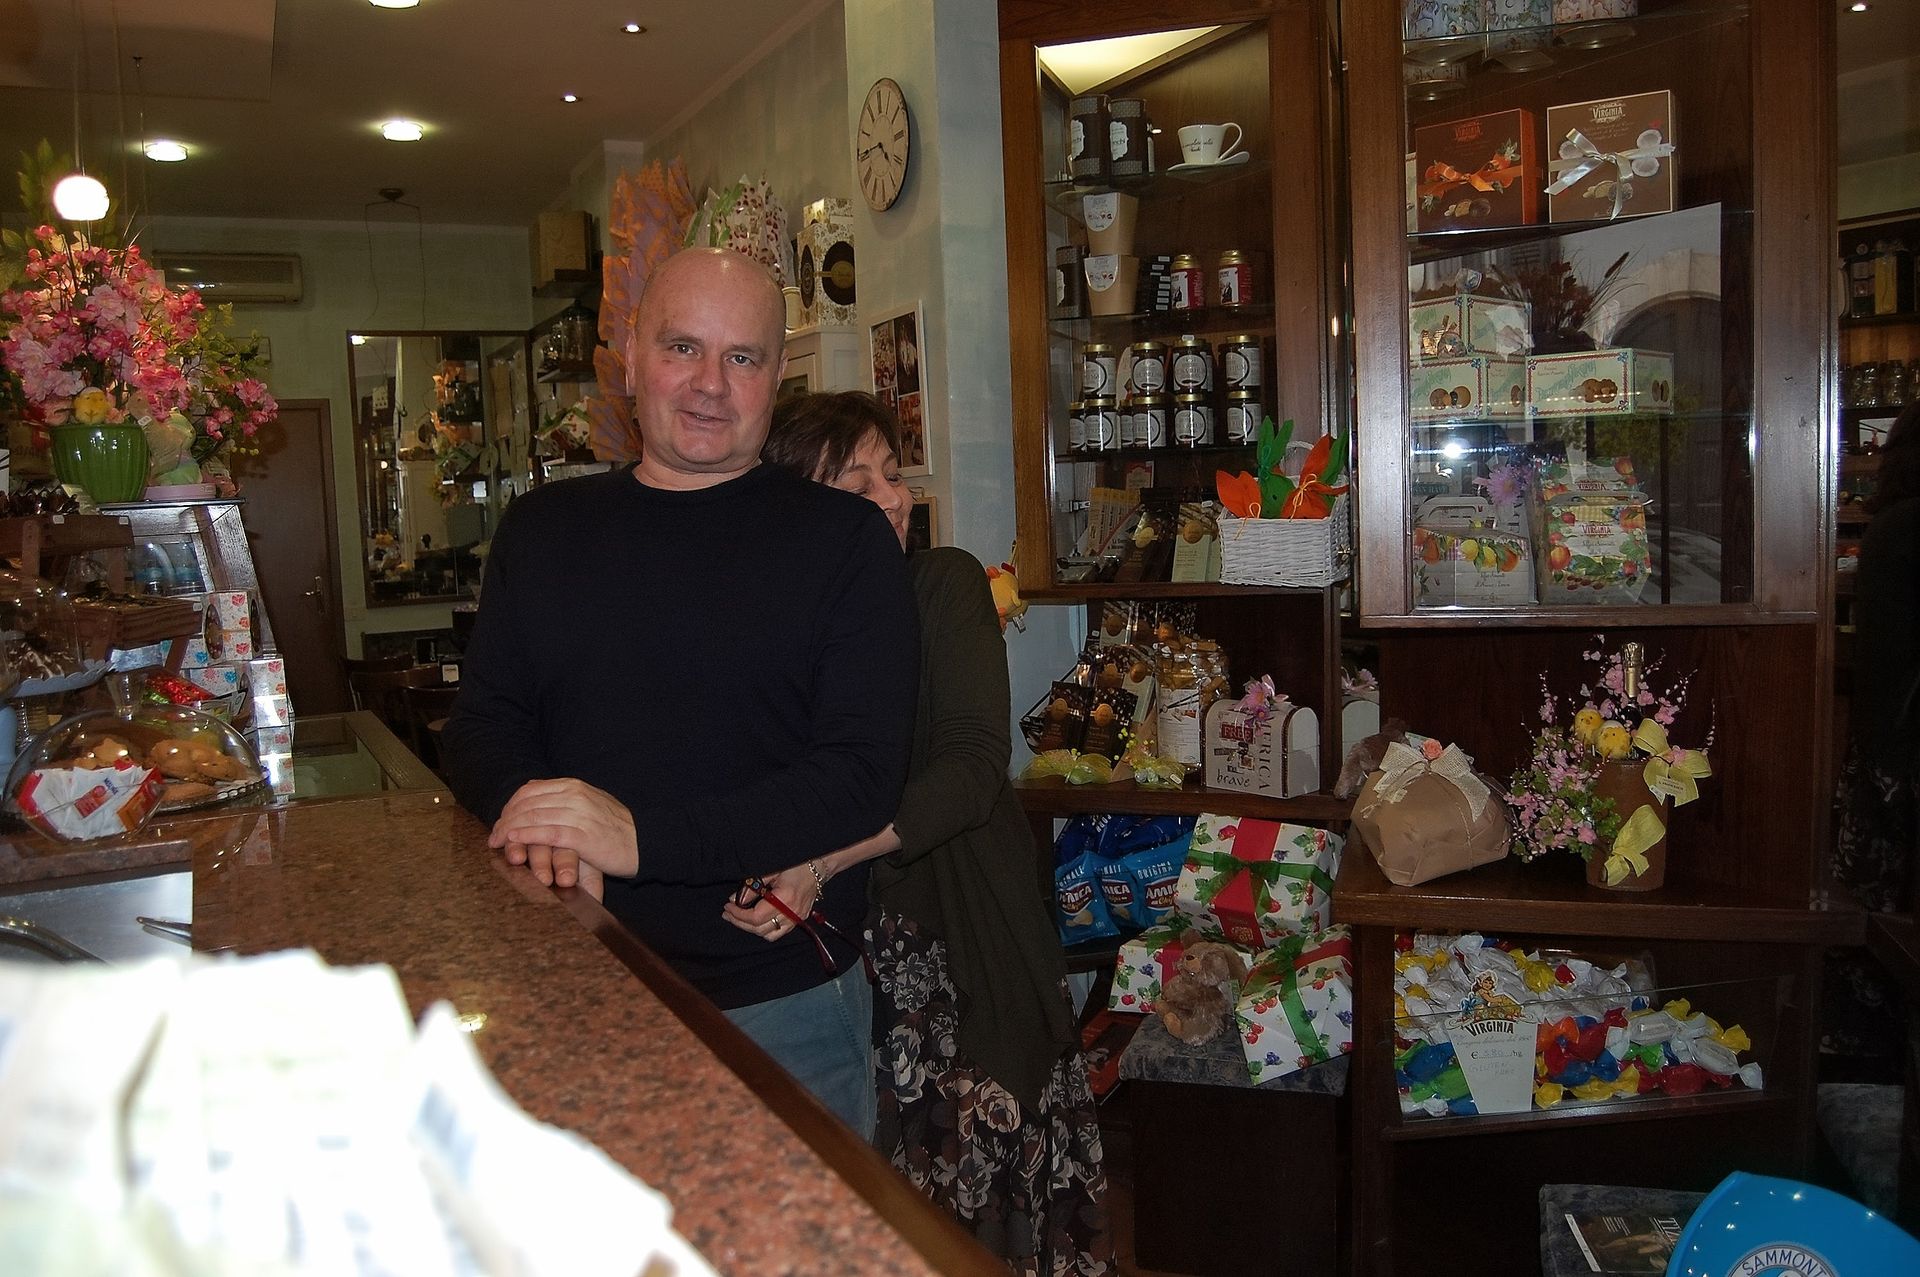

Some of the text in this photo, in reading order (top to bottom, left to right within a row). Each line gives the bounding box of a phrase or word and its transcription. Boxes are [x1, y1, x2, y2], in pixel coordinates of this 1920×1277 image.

[1592, 106, 1623, 119] VIRGINIA
[1582, 524, 1612, 534] VIRGINIA
[1216, 768, 1250, 788] brave
[1464, 1021, 1514, 1037] VIRGINIA
